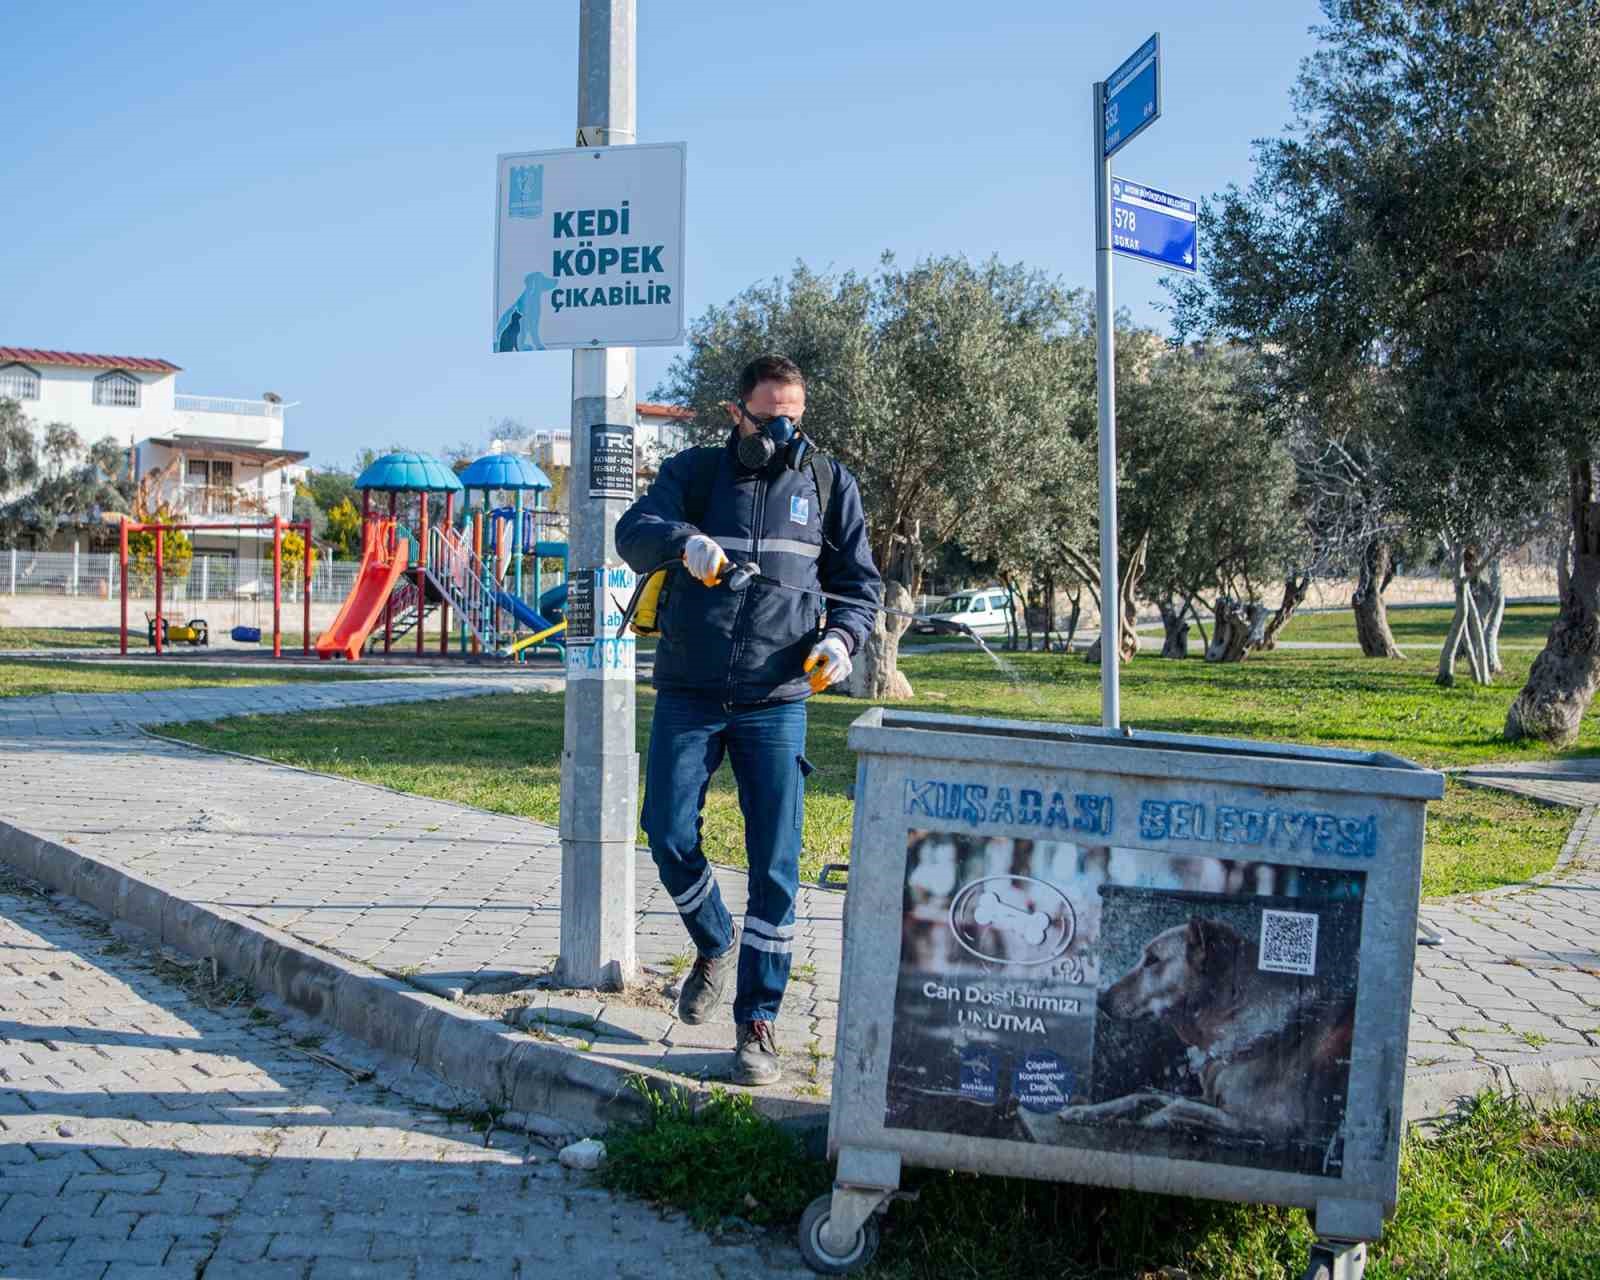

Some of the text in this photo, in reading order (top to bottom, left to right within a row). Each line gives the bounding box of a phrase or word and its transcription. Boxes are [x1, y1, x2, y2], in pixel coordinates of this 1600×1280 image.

[553, 200, 629, 239] KEDİ
[1114, 208, 1136, 232] 578
[552, 240, 664, 277] KÖPEK
[551, 280, 671, 313] ÇIKABİLİR
[903, 779, 1113, 834] KUŞADASI
[922, 981, 960, 1001] Can
